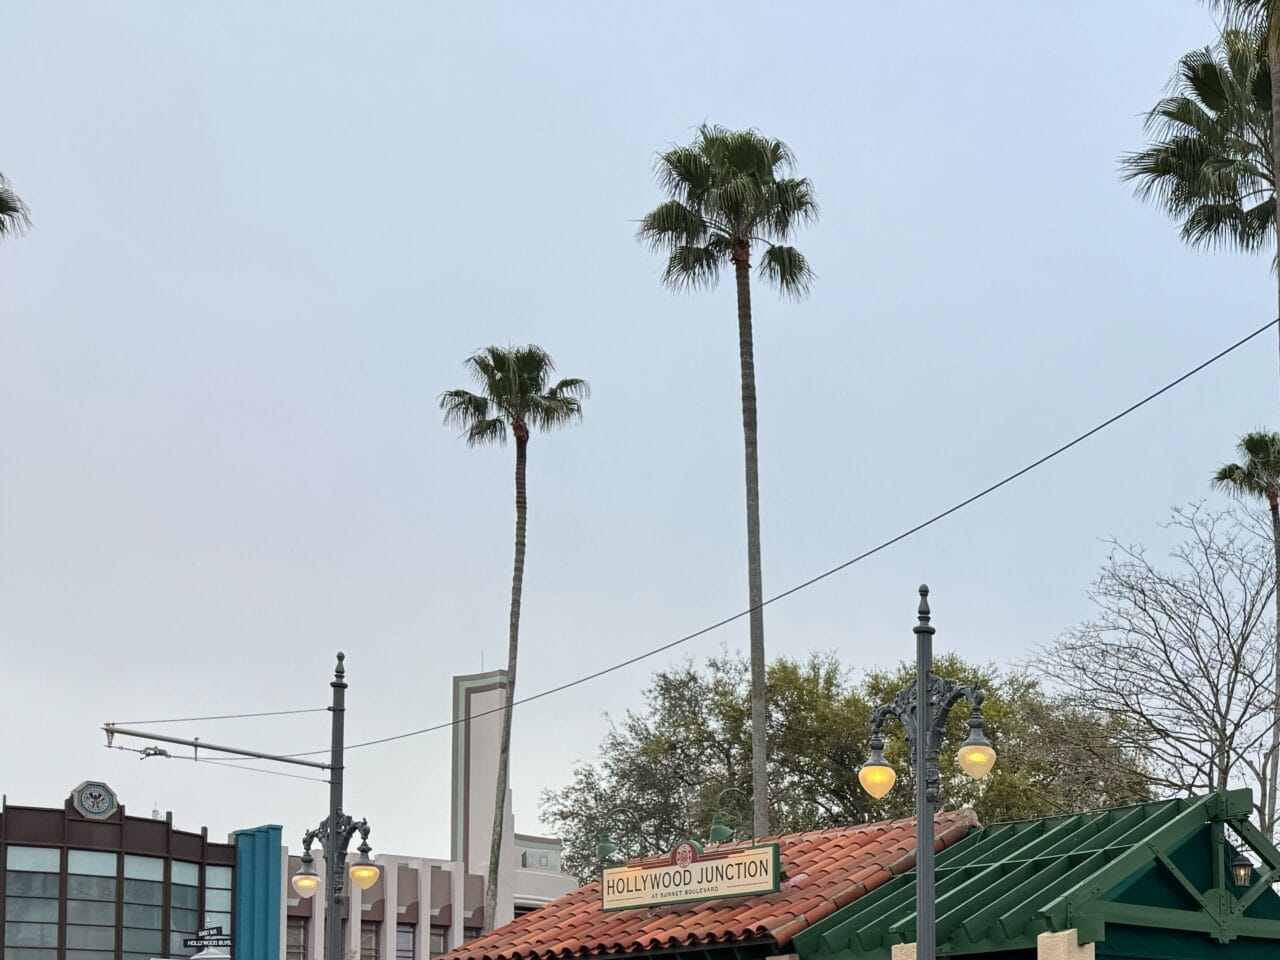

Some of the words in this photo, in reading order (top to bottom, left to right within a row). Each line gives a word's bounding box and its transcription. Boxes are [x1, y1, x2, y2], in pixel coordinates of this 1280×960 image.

[607, 869, 692, 895] HOLLYWOOD
[697, 858, 769, 884] JUNCTION
[660, 890, 683, 898] SUNSET
[685, 886, 719, 895] BOULEVARD
